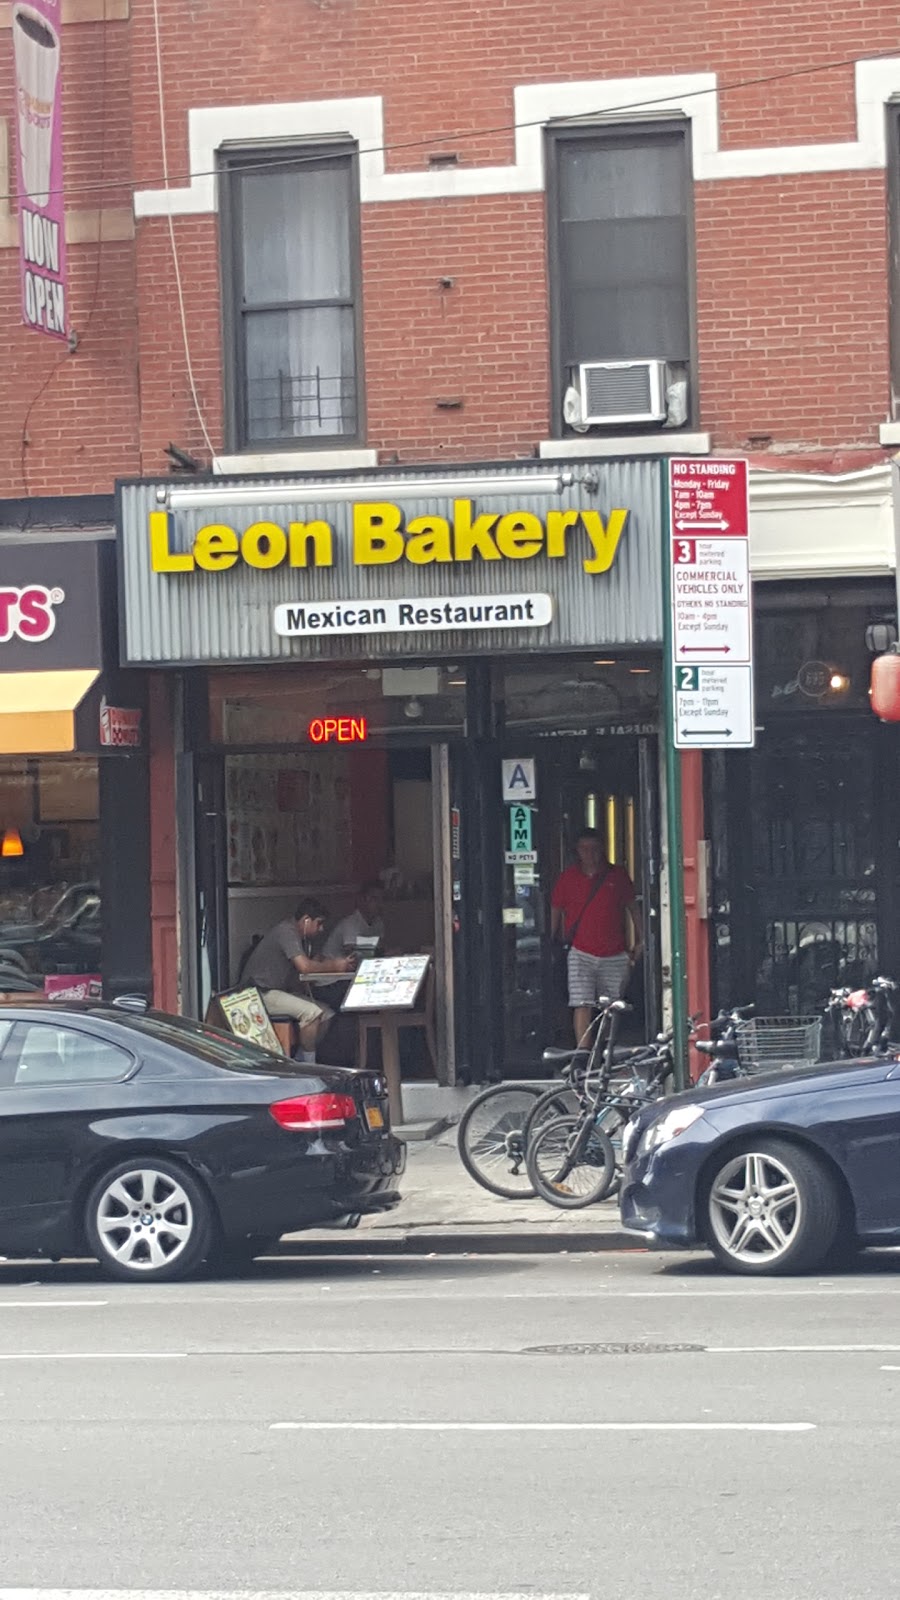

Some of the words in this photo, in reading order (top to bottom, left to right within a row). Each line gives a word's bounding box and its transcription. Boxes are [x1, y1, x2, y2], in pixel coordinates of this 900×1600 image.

[21, 208, 60, 274] NOW
[24, 269, 66, 335] OPEN
[673, 463, 687, 474] NO
[689, 463, 736, 475] STANDING
[673, 480, 701, 490] Monday
[707, 480, 730, 491] Friday
[674, 490, 690, 499] 7am
[696, 490, 715, 499] 10am
[674, 501, 690, 510] 4pm
[696, 501, 712, 511] 7pm
[675, 511, 698, 520] Except
[699, 511, 723, 520] Sunday
[149, 510, 333, 574] Leon
[353, 499, 630, 575] Bakery
[678, 541, 691, 563] 3
[676, 571, 737, 581] COMMERCIAL
[677, 584, 718, 594] VEHICLES
[721, 584, 744, 594] ONLY
[677, 600, 703, 608] OTHERS
[704, 600, 714, 608] NO
[715, 600, 749, 608] STANDING
[286, 604, 388, 632] Mexican
[398, 598, 534, 627] Restaurant
[677, 612, 695, 620] 10am
[702, 612, 717, 621] 4pm
[678, 622, 701, 632] Except
[703, 622, 729, 632] Sunday
[680, 667, 694, 690] 2
[679, 698, 694, 707] 7pm
[679, 707, 702, 717] Except
[704, 707, 729, 717] Sunday
[308, 717, 367, 743] OPEN
[508, 763, 530, 789] A
